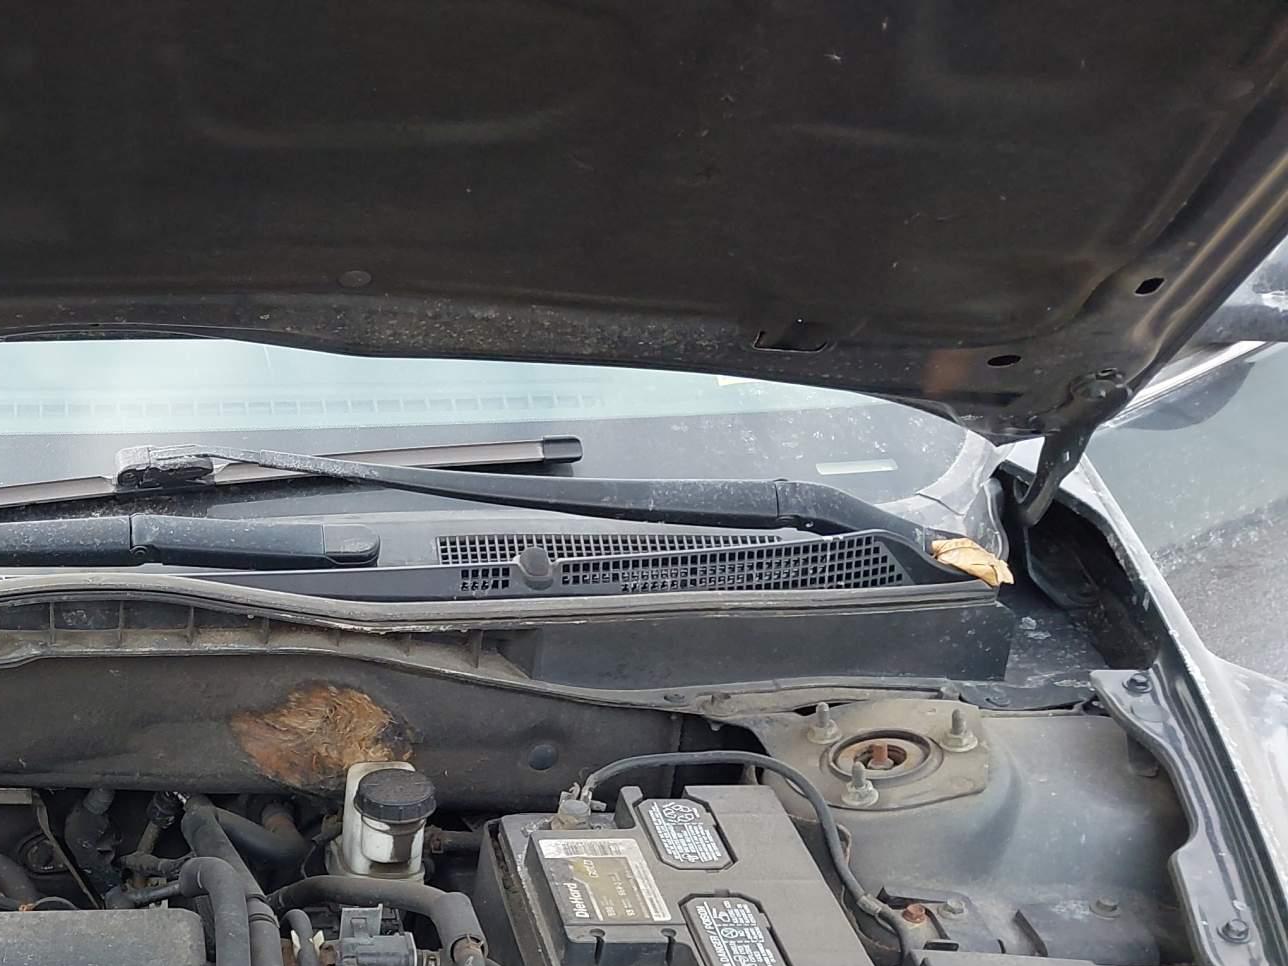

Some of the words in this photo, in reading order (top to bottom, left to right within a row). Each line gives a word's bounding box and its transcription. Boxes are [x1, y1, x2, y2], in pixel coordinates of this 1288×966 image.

[563, 882, 590, 919] DieHard
[696, 905, 713, 930] POISON
[707, 935, 730, 962] DANGER
